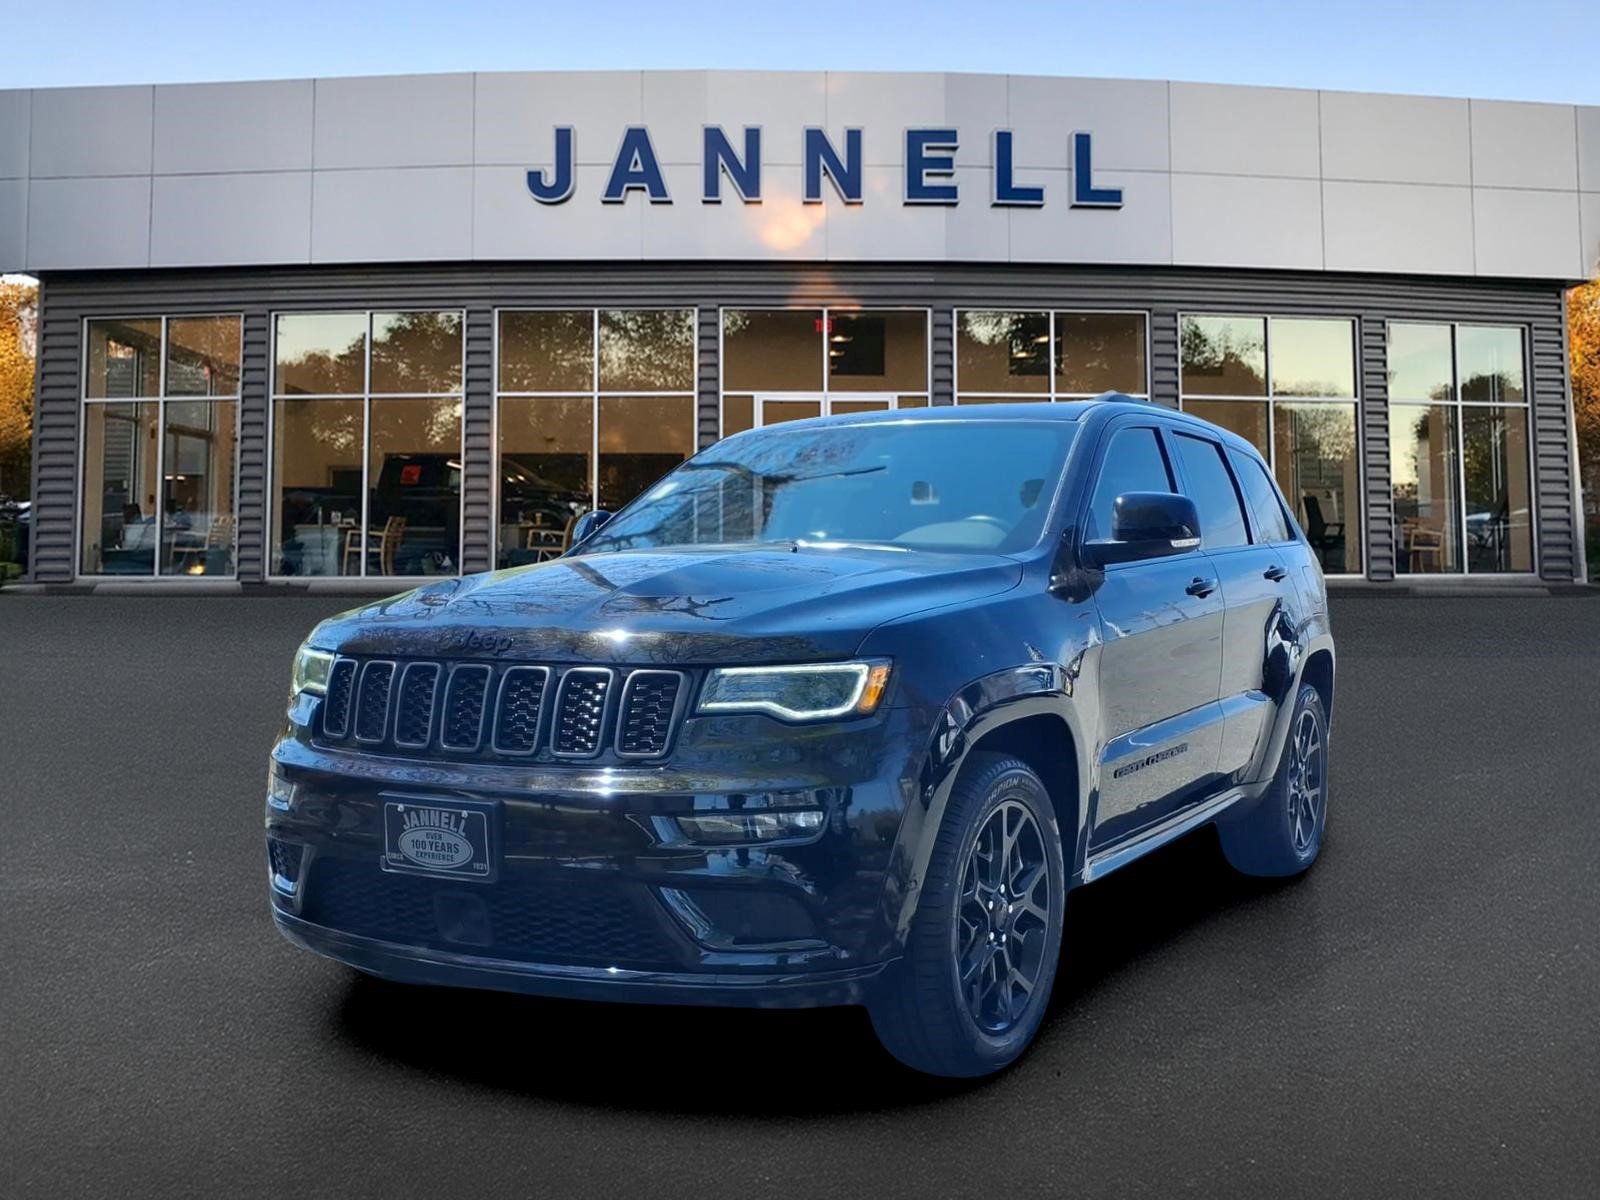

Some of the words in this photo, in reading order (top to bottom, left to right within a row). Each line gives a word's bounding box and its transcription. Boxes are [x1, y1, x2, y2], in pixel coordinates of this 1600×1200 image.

[526, 123, 1124, 208] JANNELL
[459, 630, 514, 656] Jeep
[403, 810, 467, 837] JANNELL
[411, 839, 427, 850] 100
[428, 840, 460, 854] YEARS
[425, 832, 443, 841] OVER
[415, 850, 455, 862] EXPERIENCE
